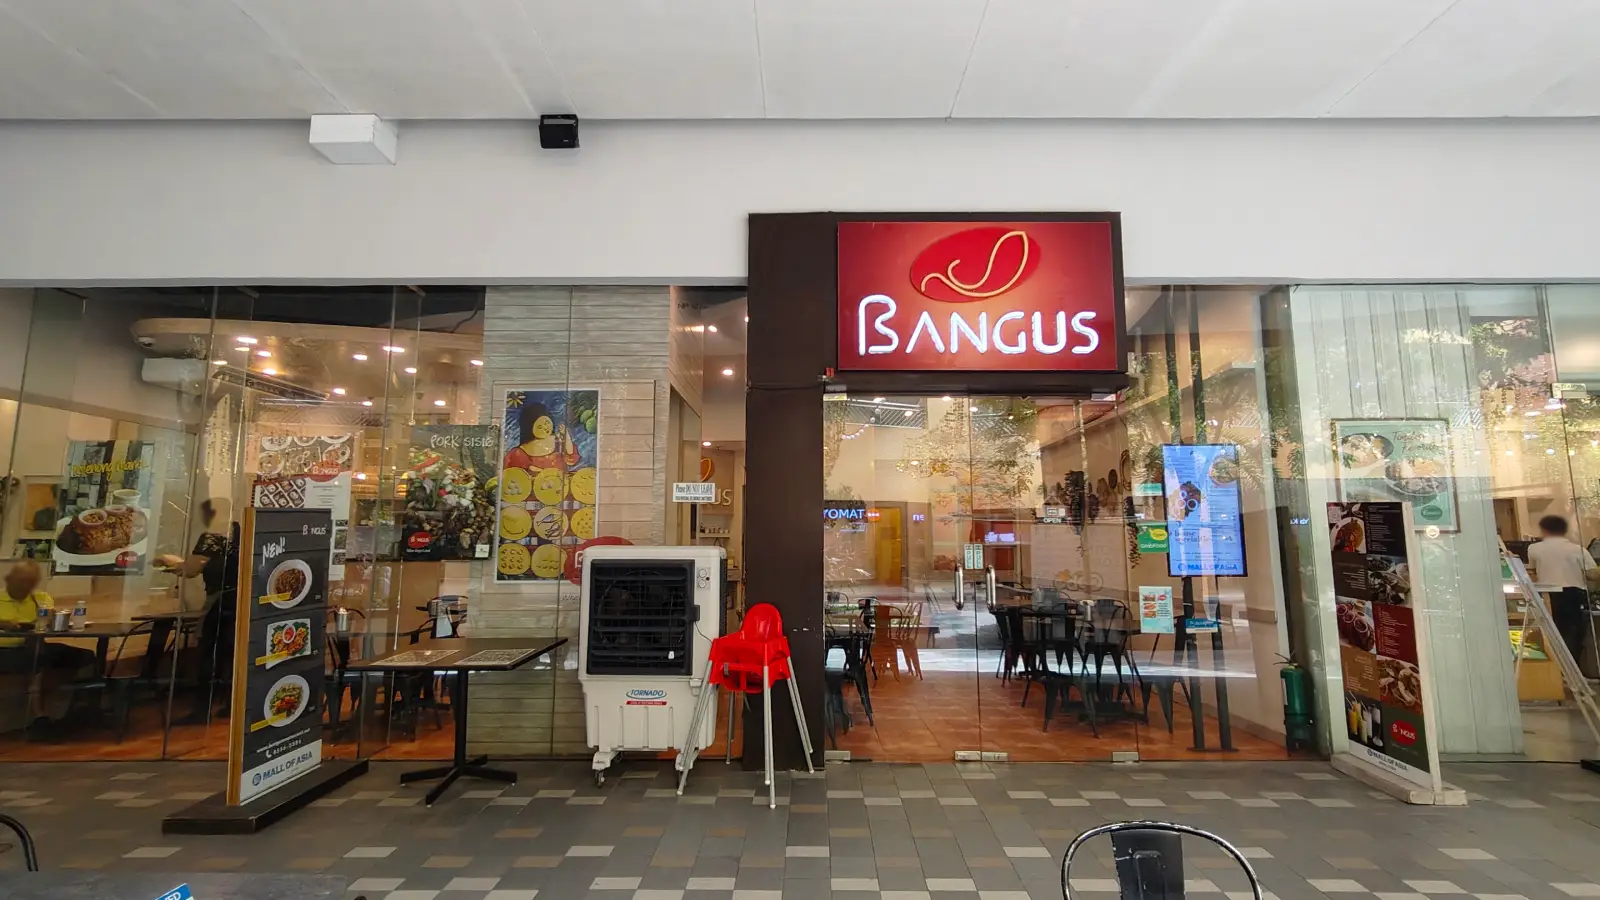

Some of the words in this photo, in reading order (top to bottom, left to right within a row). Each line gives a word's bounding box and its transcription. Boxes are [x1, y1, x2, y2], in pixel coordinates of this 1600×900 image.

[858, 294, 1099, 356] BANGUS
[430, 434, 460, 450] PORK
[630, 689, 664, 697] TORNADO
[262, 765, 286, 781] MALL
[296, 751, 313, 766] ASIA
